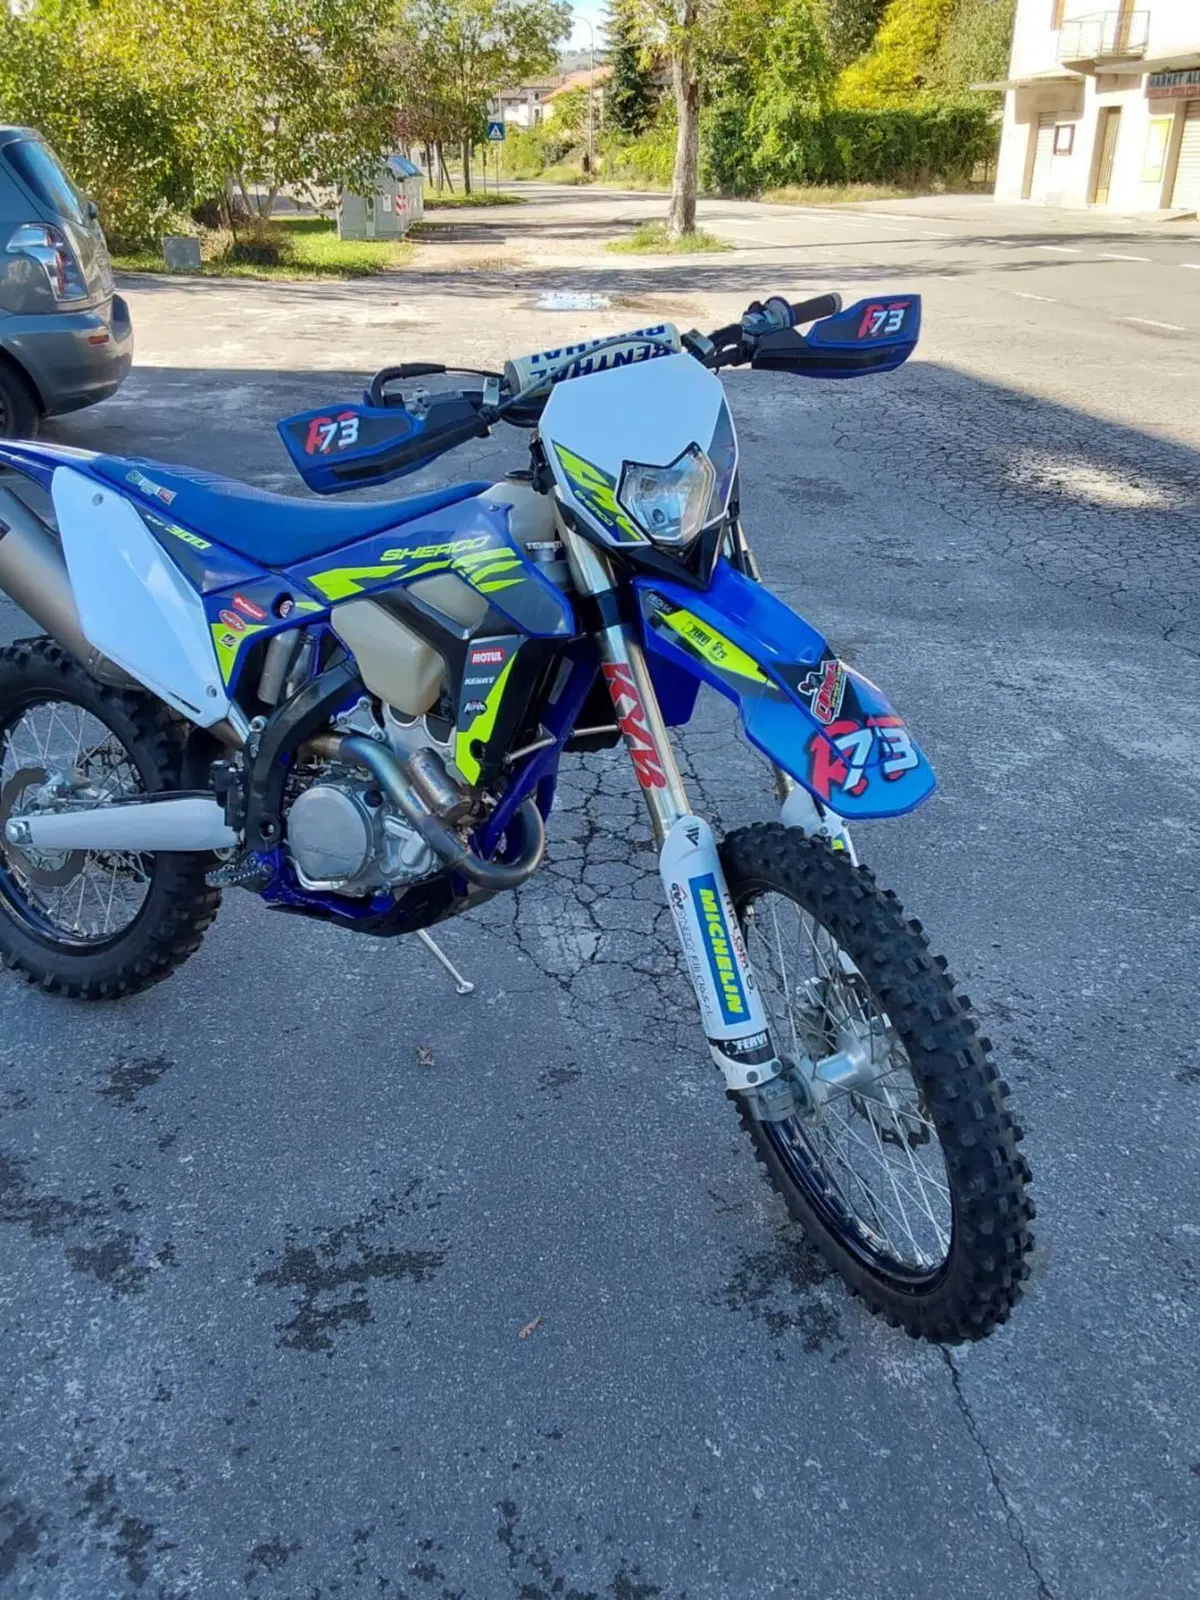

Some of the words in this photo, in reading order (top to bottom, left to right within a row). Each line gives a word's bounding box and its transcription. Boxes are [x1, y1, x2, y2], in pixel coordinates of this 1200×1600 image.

[380, 534, 491, 562] SHERCO
[472, 651, 503, 664] MOTUL
[601, 663, 667, 789] KYB
[699, 888, 744, 1014] MICHELIN
